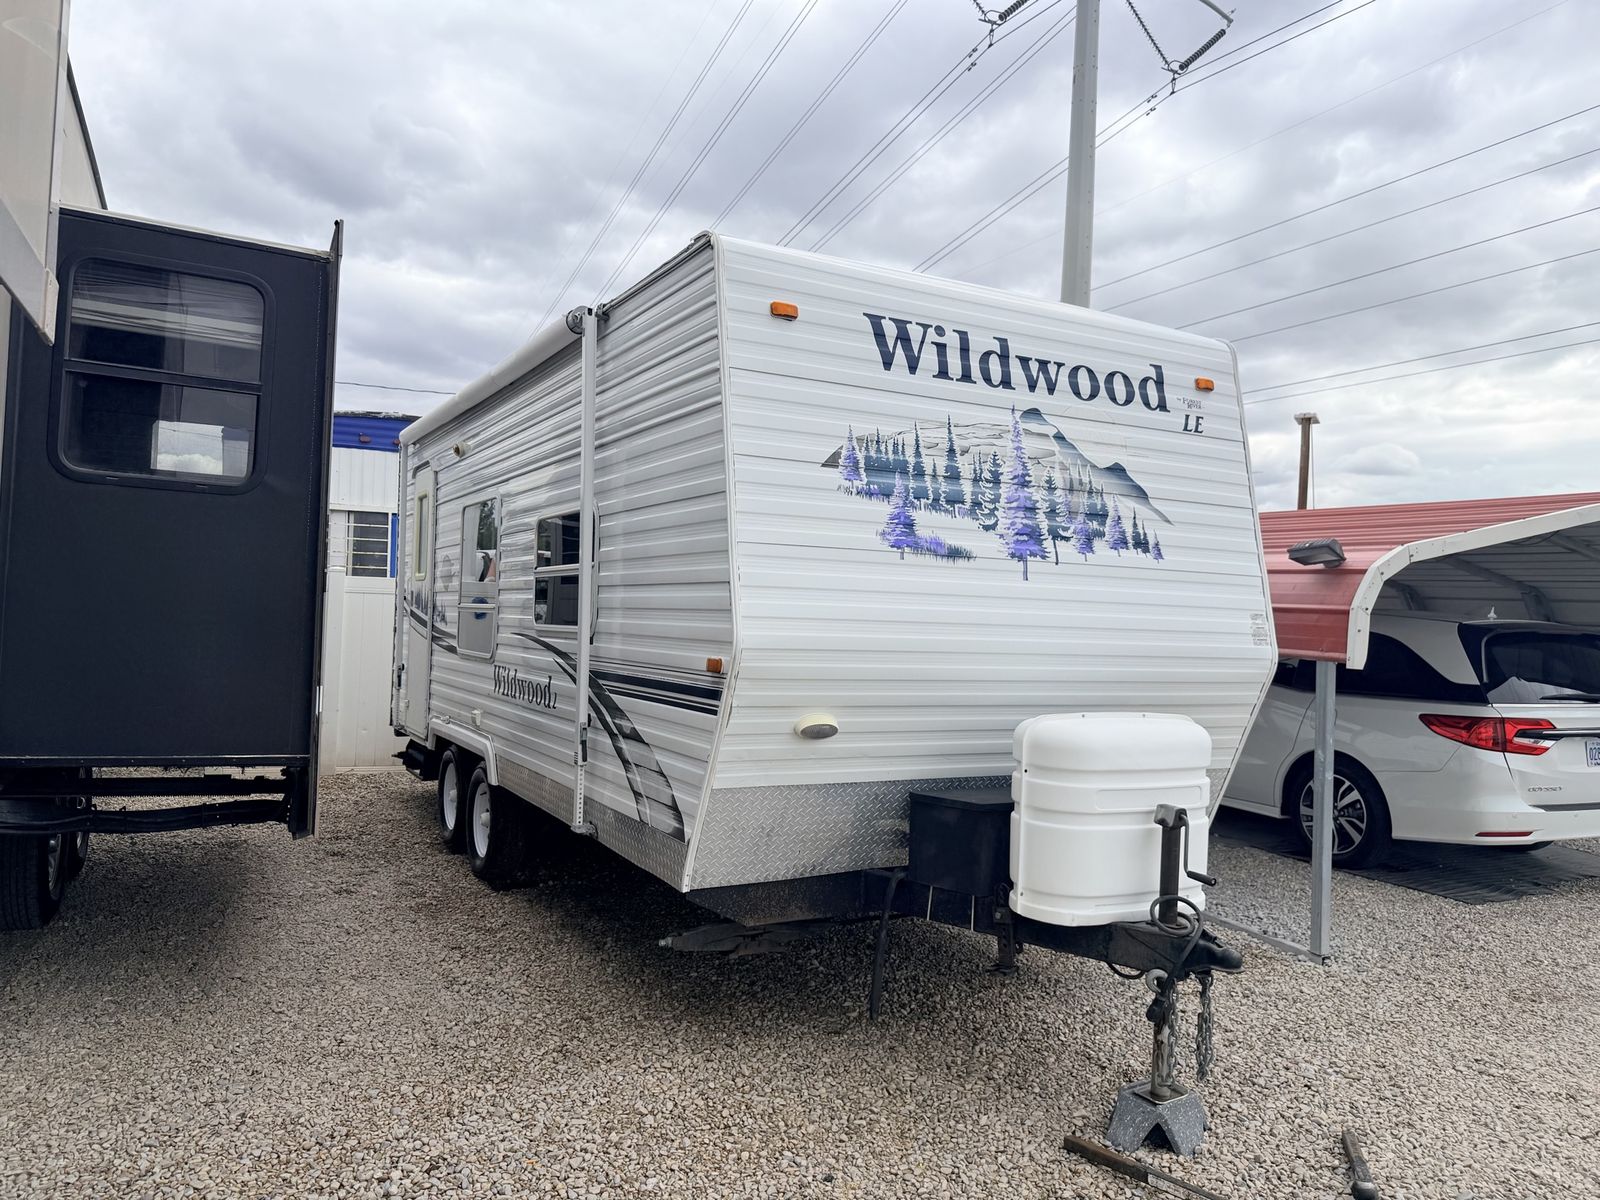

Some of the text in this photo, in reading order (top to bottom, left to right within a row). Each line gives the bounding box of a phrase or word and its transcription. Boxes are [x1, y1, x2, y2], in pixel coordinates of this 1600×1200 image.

[863, 313, 1170, 413] Wildwood
[1183, 414, 1204, 434] LE
[493, 664, 552, 709] Wildwood
